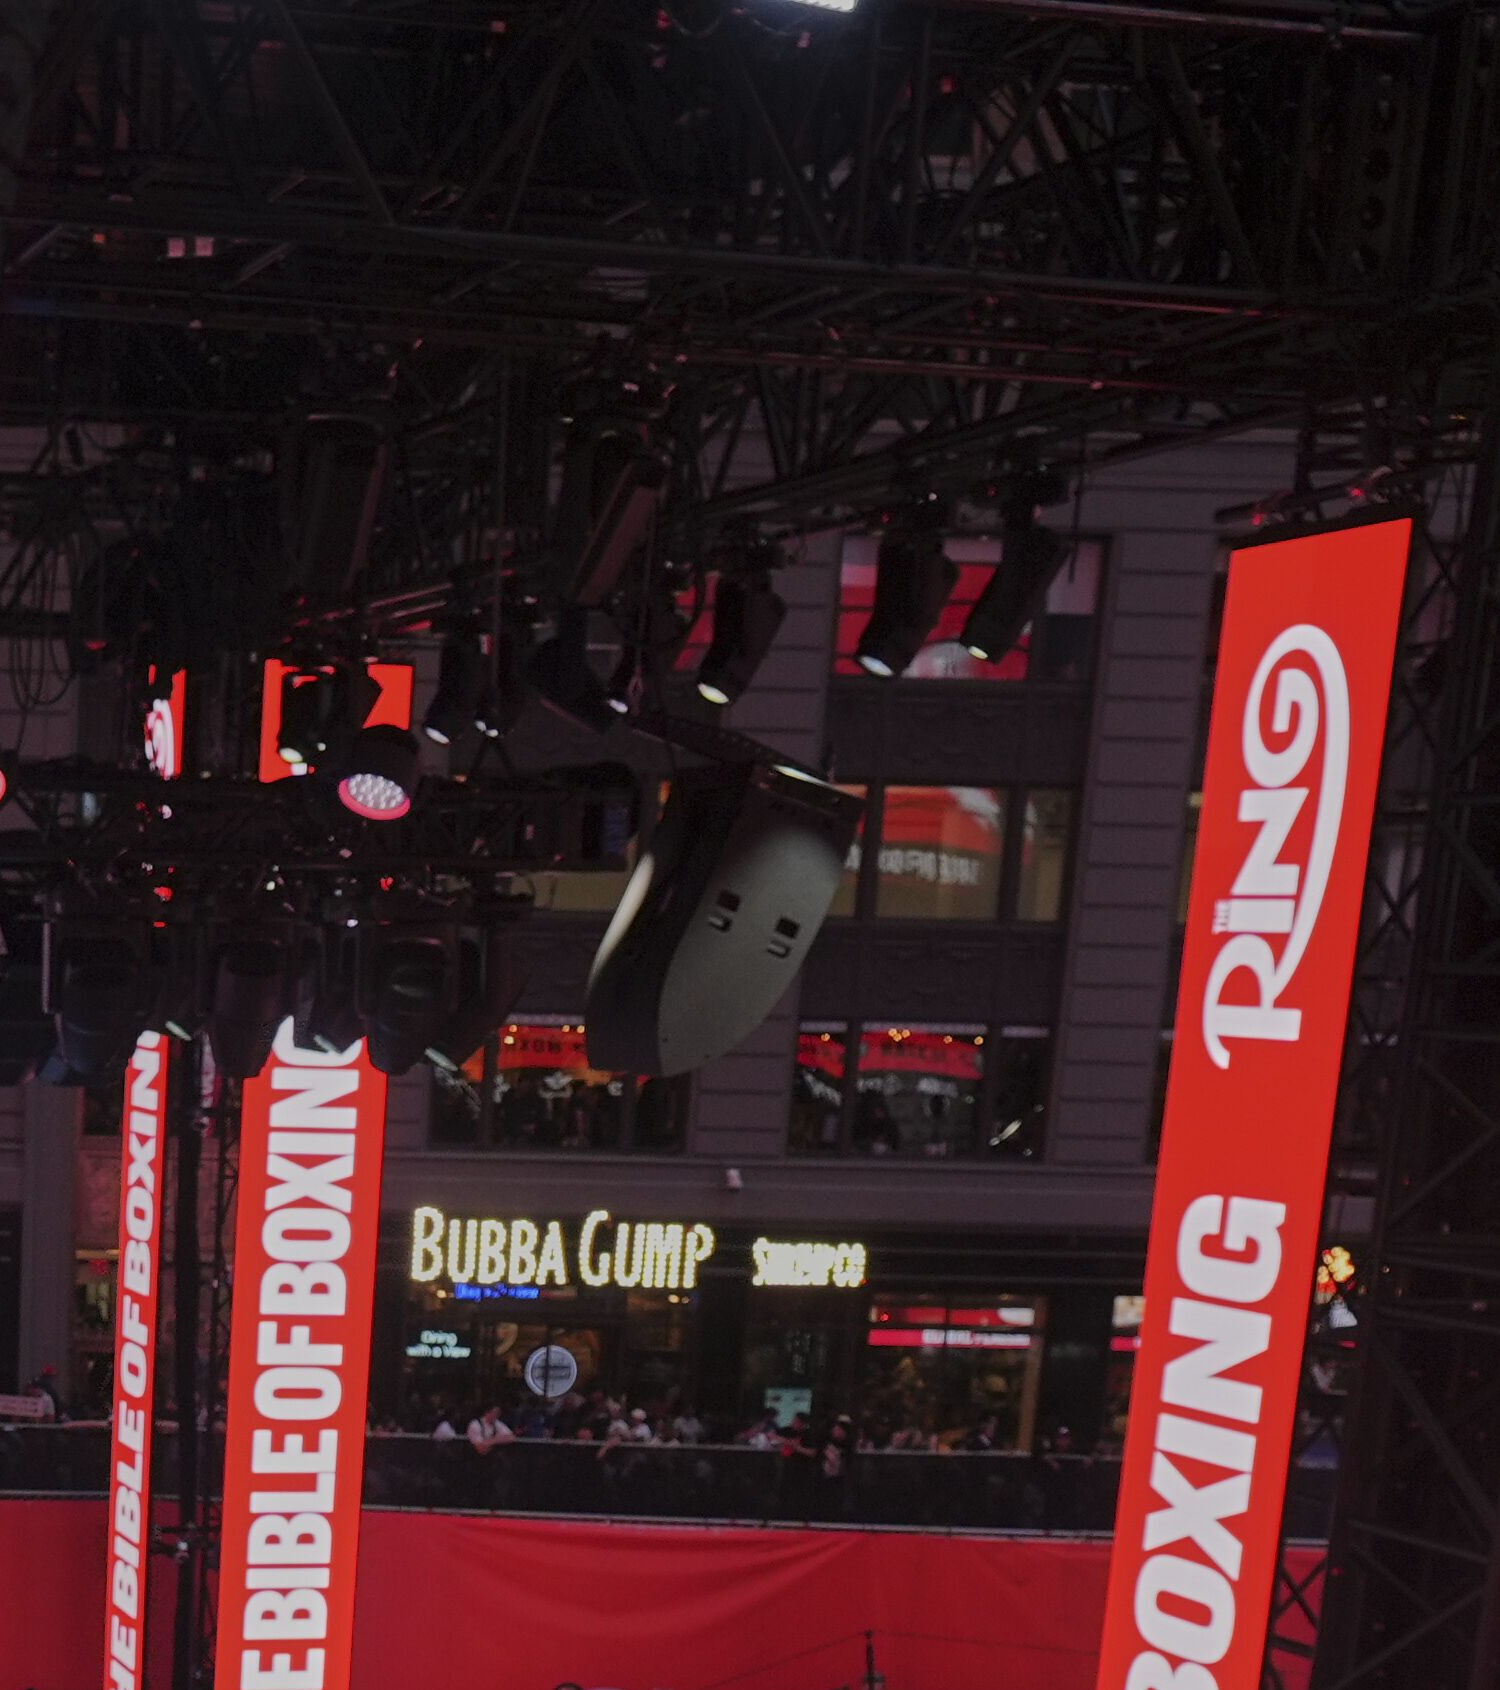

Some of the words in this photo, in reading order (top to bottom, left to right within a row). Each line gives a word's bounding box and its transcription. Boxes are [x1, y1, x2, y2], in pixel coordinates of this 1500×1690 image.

[1204, 625, 1349, 1068] RING
[1212, 892, 1231, 934] THE
[125, 1031, 160, 1295] BOXIN
[411, 1207, 569, 1287] BUBBA
[578, 1210, 715, 1290] GUMP
[121, 1296, 147, 1397] OF
[254, 1321, 343, 1420] OF
[113, 1402, 144, 1618] BIBLE
[244, 1430, 338, 1640] BIBLE
